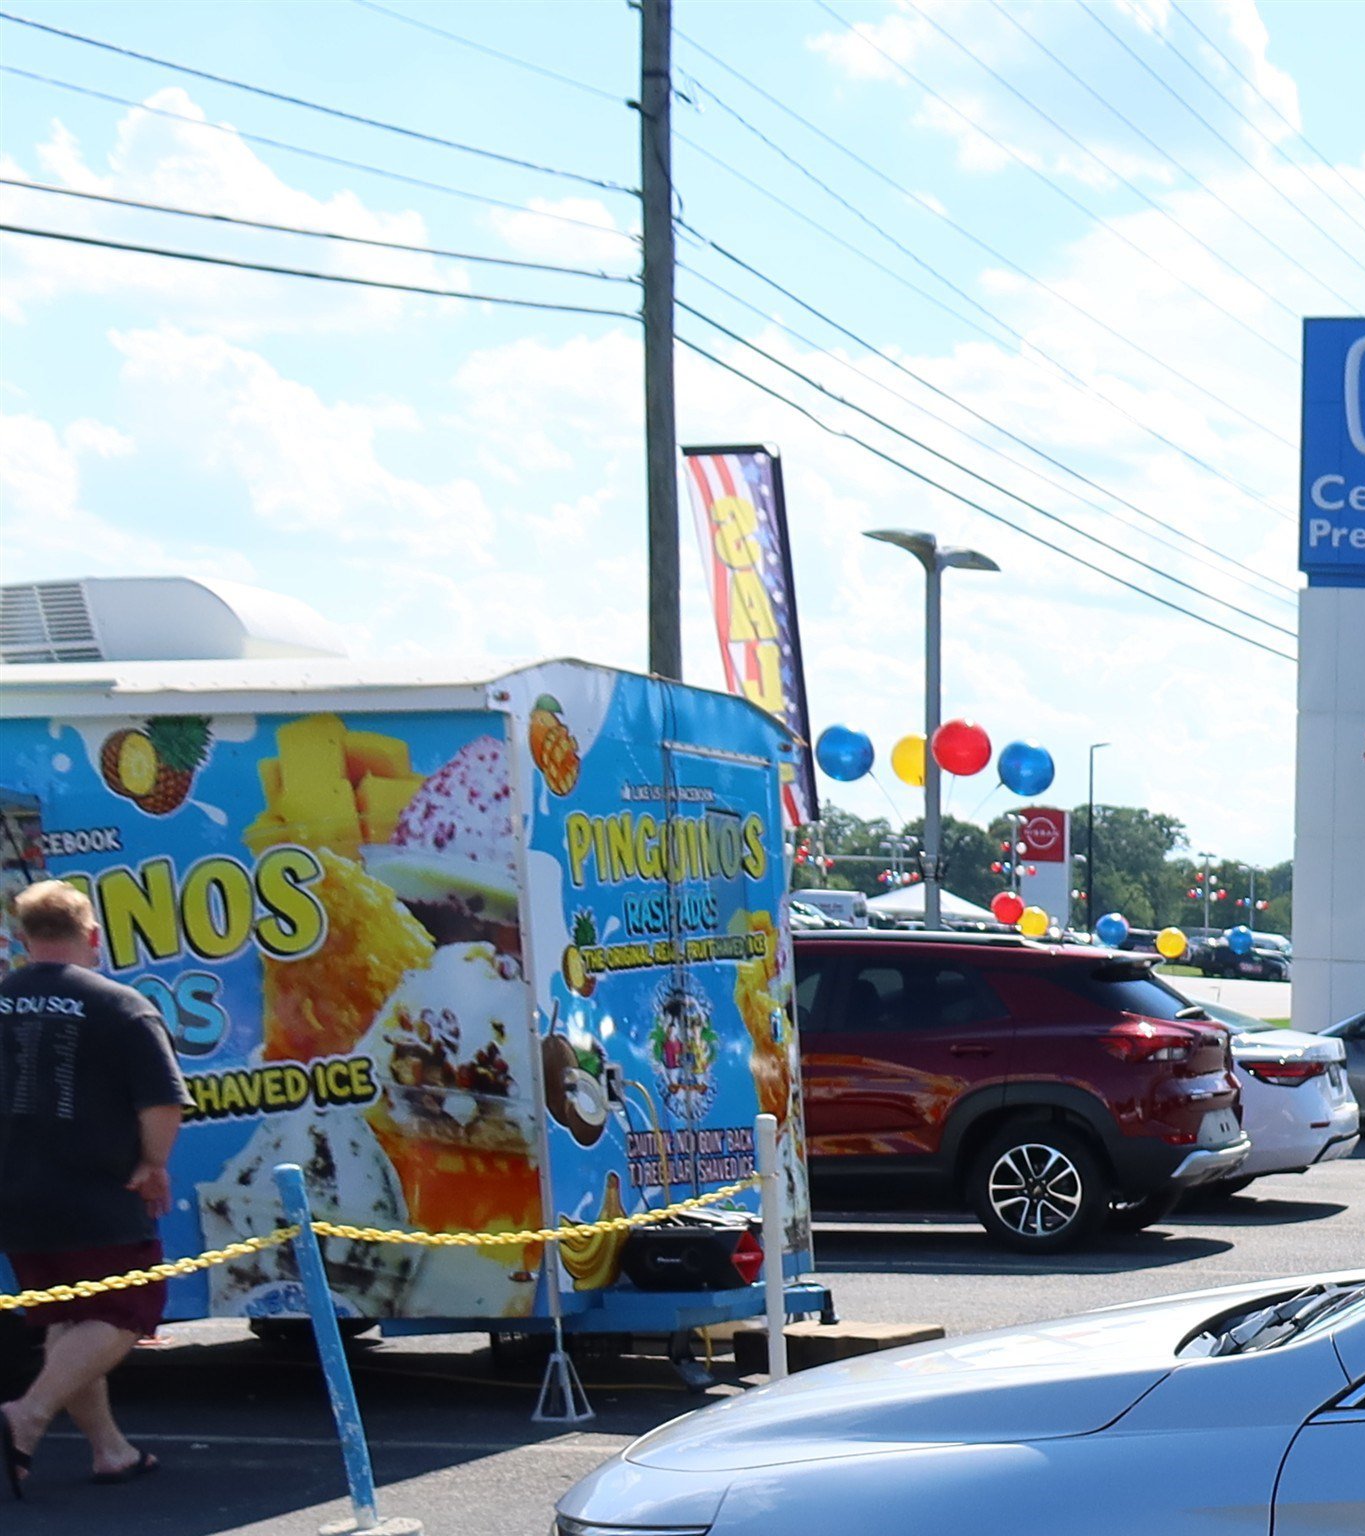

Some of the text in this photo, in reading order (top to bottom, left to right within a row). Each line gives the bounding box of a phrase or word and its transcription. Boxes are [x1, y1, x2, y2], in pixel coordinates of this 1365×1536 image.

[565, 812, 767, 887] PINGUINOS
[312, 1058, 376, 1106] ICE
[726, 1127, 754, 1151] BACK
[697, 1156, 738, 1183] SHAVED
